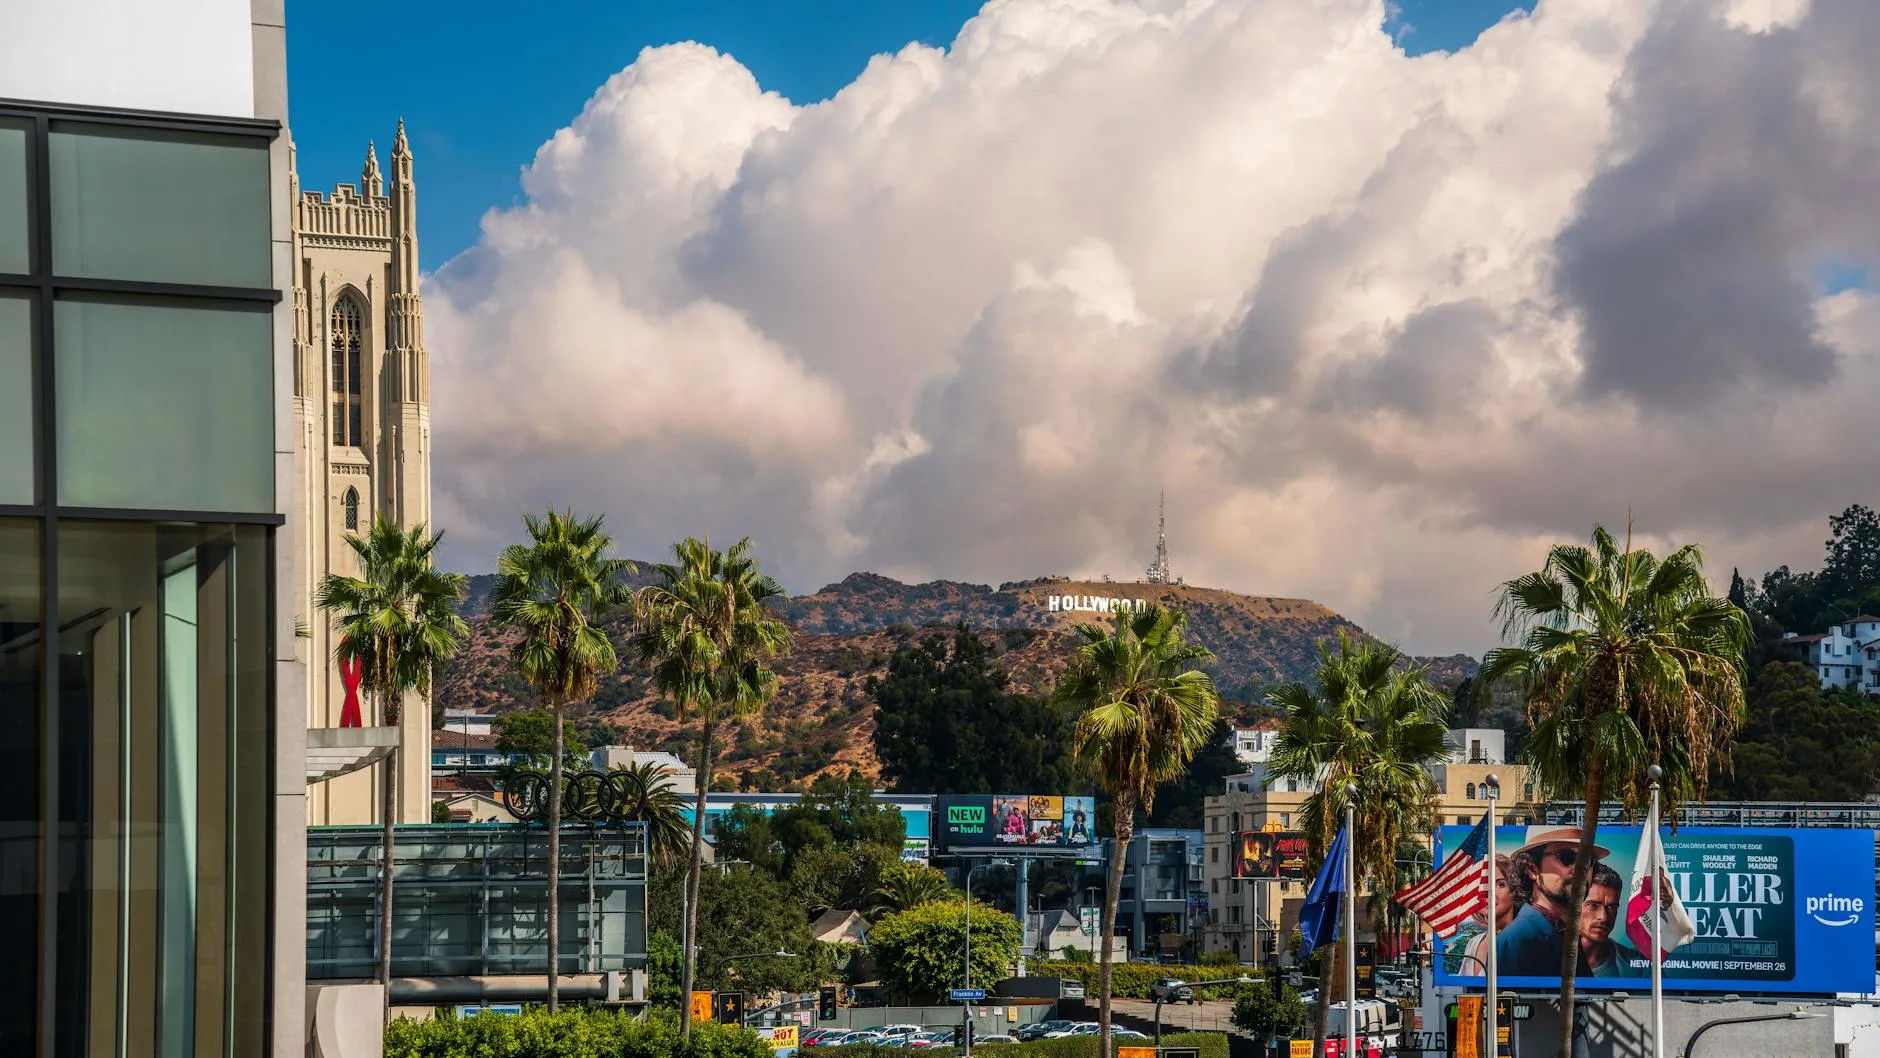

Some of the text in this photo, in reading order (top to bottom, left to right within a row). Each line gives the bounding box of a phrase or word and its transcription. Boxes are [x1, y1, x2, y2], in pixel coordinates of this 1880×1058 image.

[1048, 595, 1147, 614] HOLLYWOOD
[950, 808, 982, 821] NEW
[960, 824, 984, 834] hulu
[1702, 854, 1736, 862] SHAILENE
[1747, 855, 1778, 863] RICHARD
[1667, 861, 1691, 869] LEVITT
[1702, 862, 1737, 870] WOODLEY
[1747, 862, 1778, 870] MADDEN
[1670, 872, 1784, 905] LLER
[1806, 892, 1864, 915] prime
[1687, 906, 1762, 939] EAT
[1629, 959, 1650, 969] NEW
[1691, 961, 1720, 970] MOVIE
[1723, 961, 1774, 971] SEPTEMBER
[1774, 963, 1786, 972] 26
